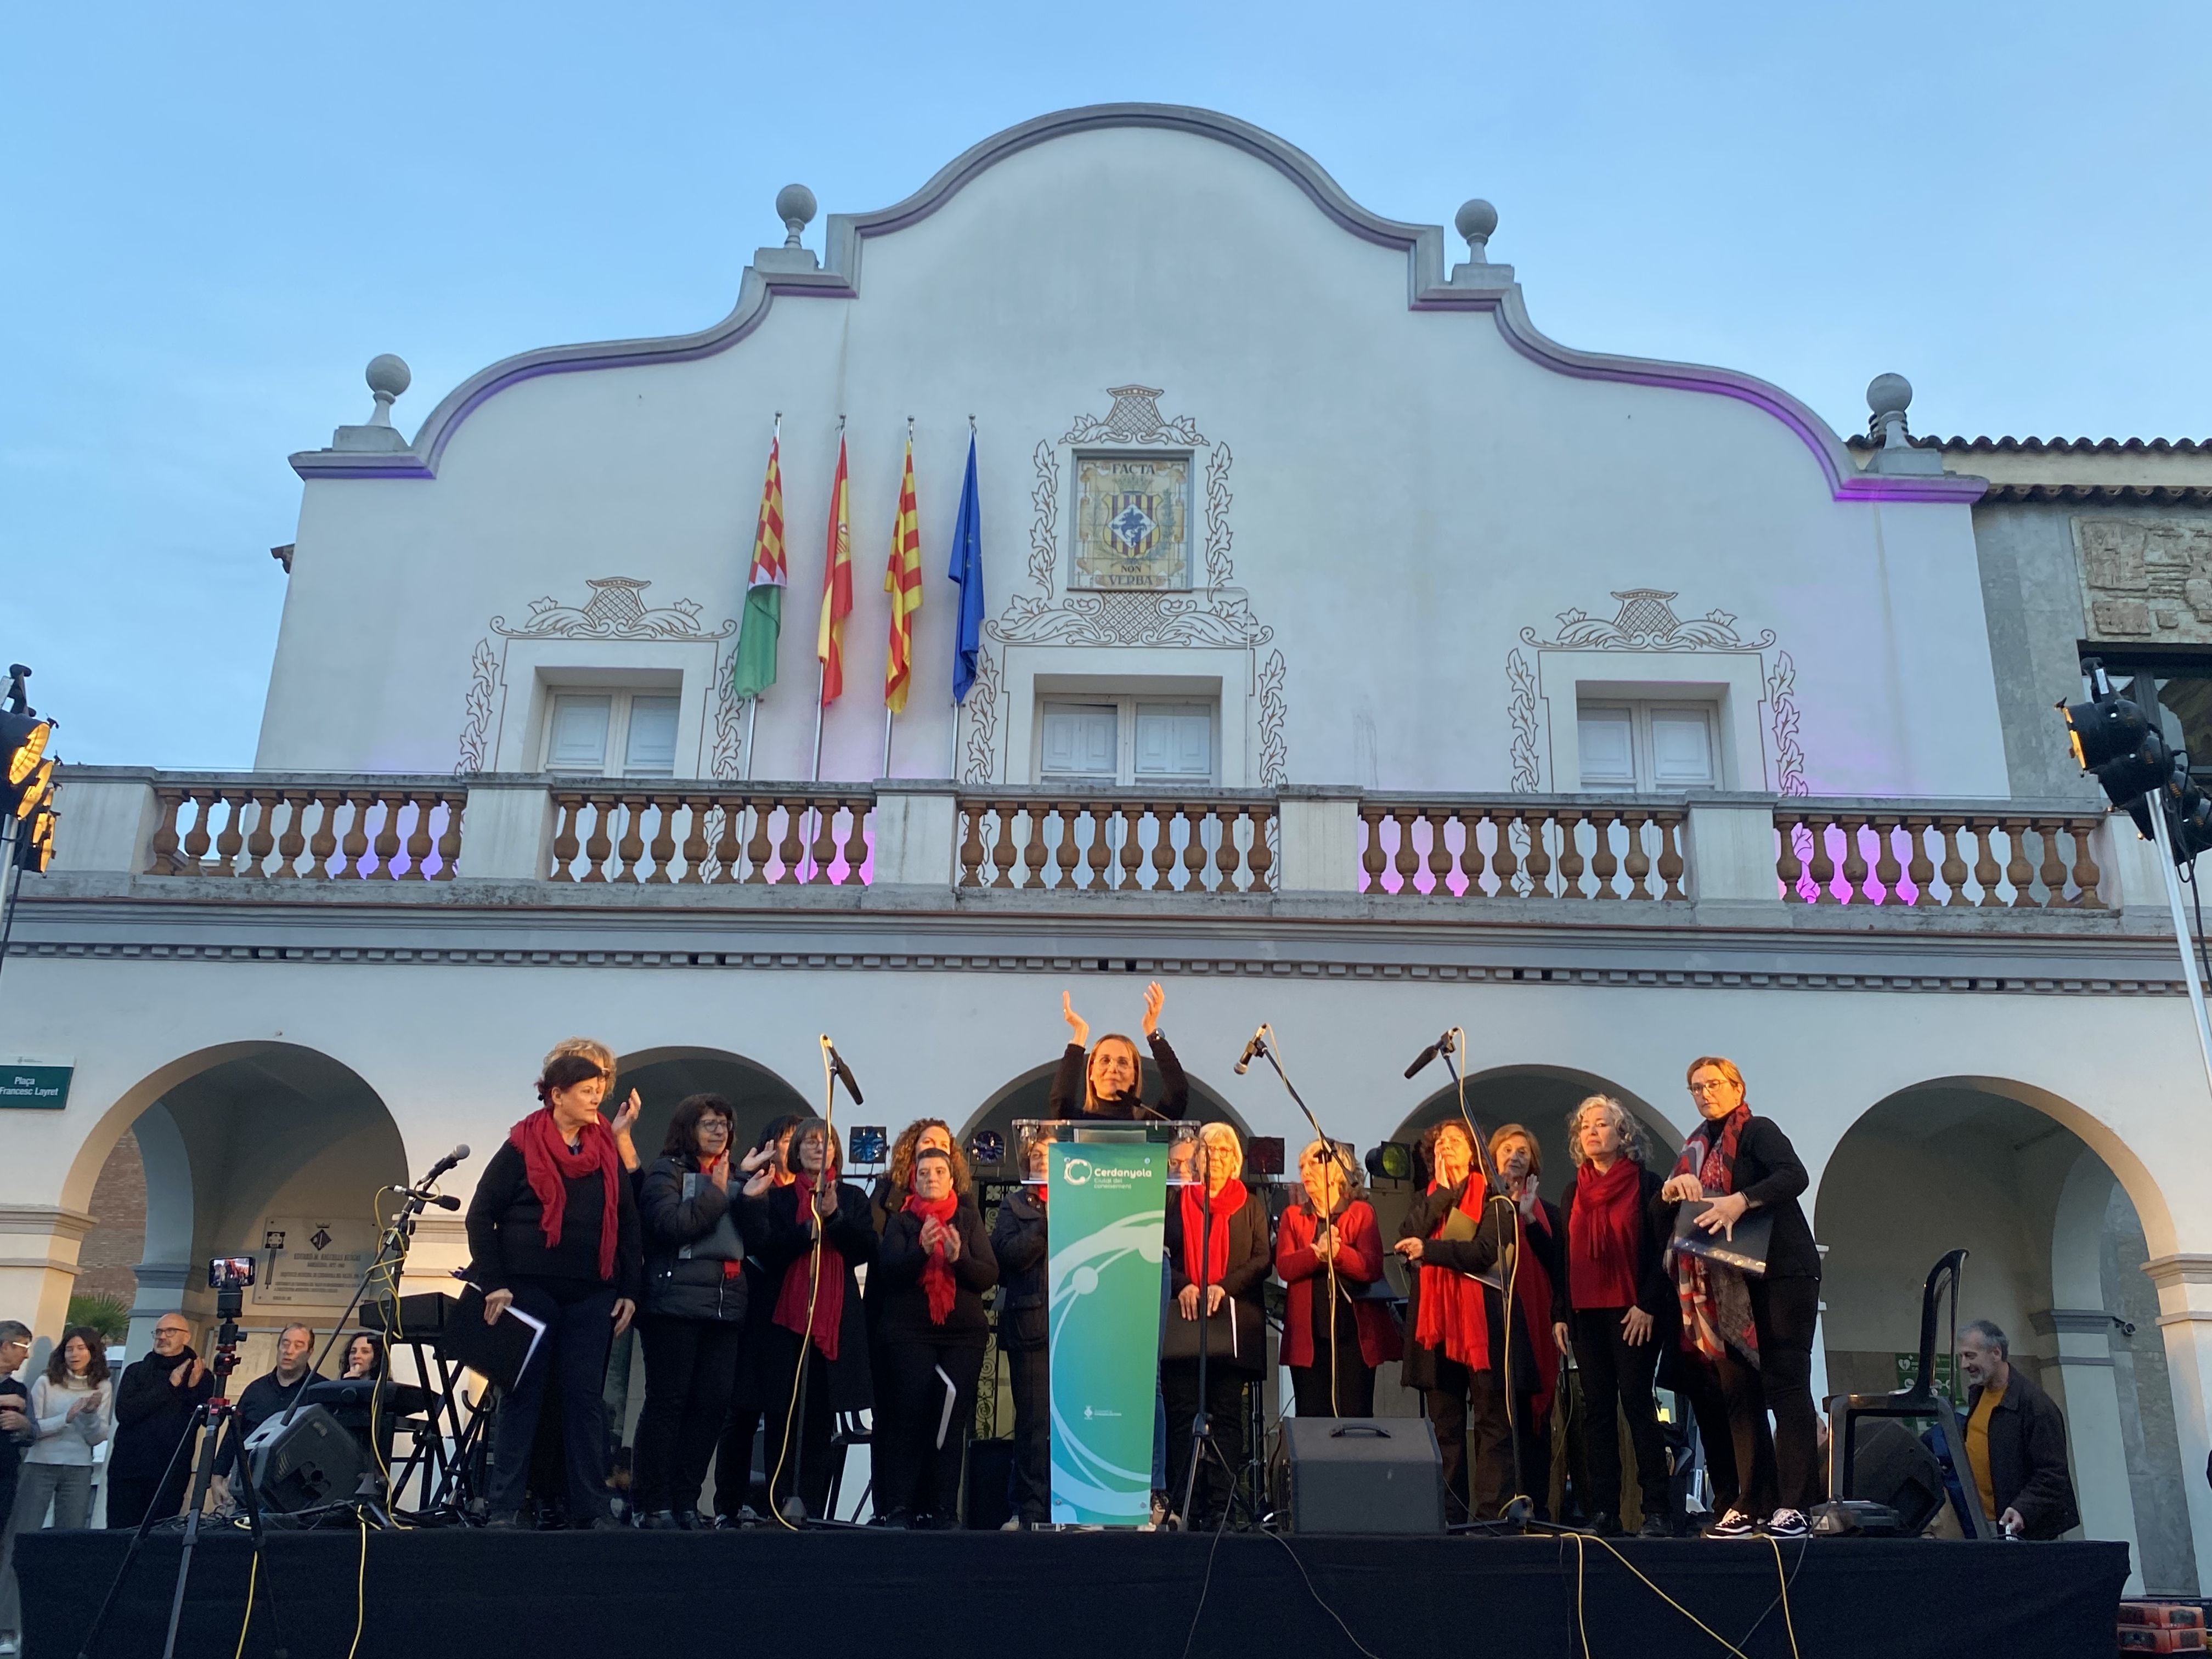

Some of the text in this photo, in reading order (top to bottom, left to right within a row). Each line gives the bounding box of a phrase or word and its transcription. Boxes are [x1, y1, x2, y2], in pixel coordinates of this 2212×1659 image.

[1113, 464, 1155, 475] FACTA
[1121, 565, 1141, 573] NON
[1108, 575, 1153, 585] VERBA
[14, 1076, 35, 1086] Plaça
[0, 1087, 59, 1097] Francesc Layret
[1094, 1167, 1152, 1179] Cerdanyola
